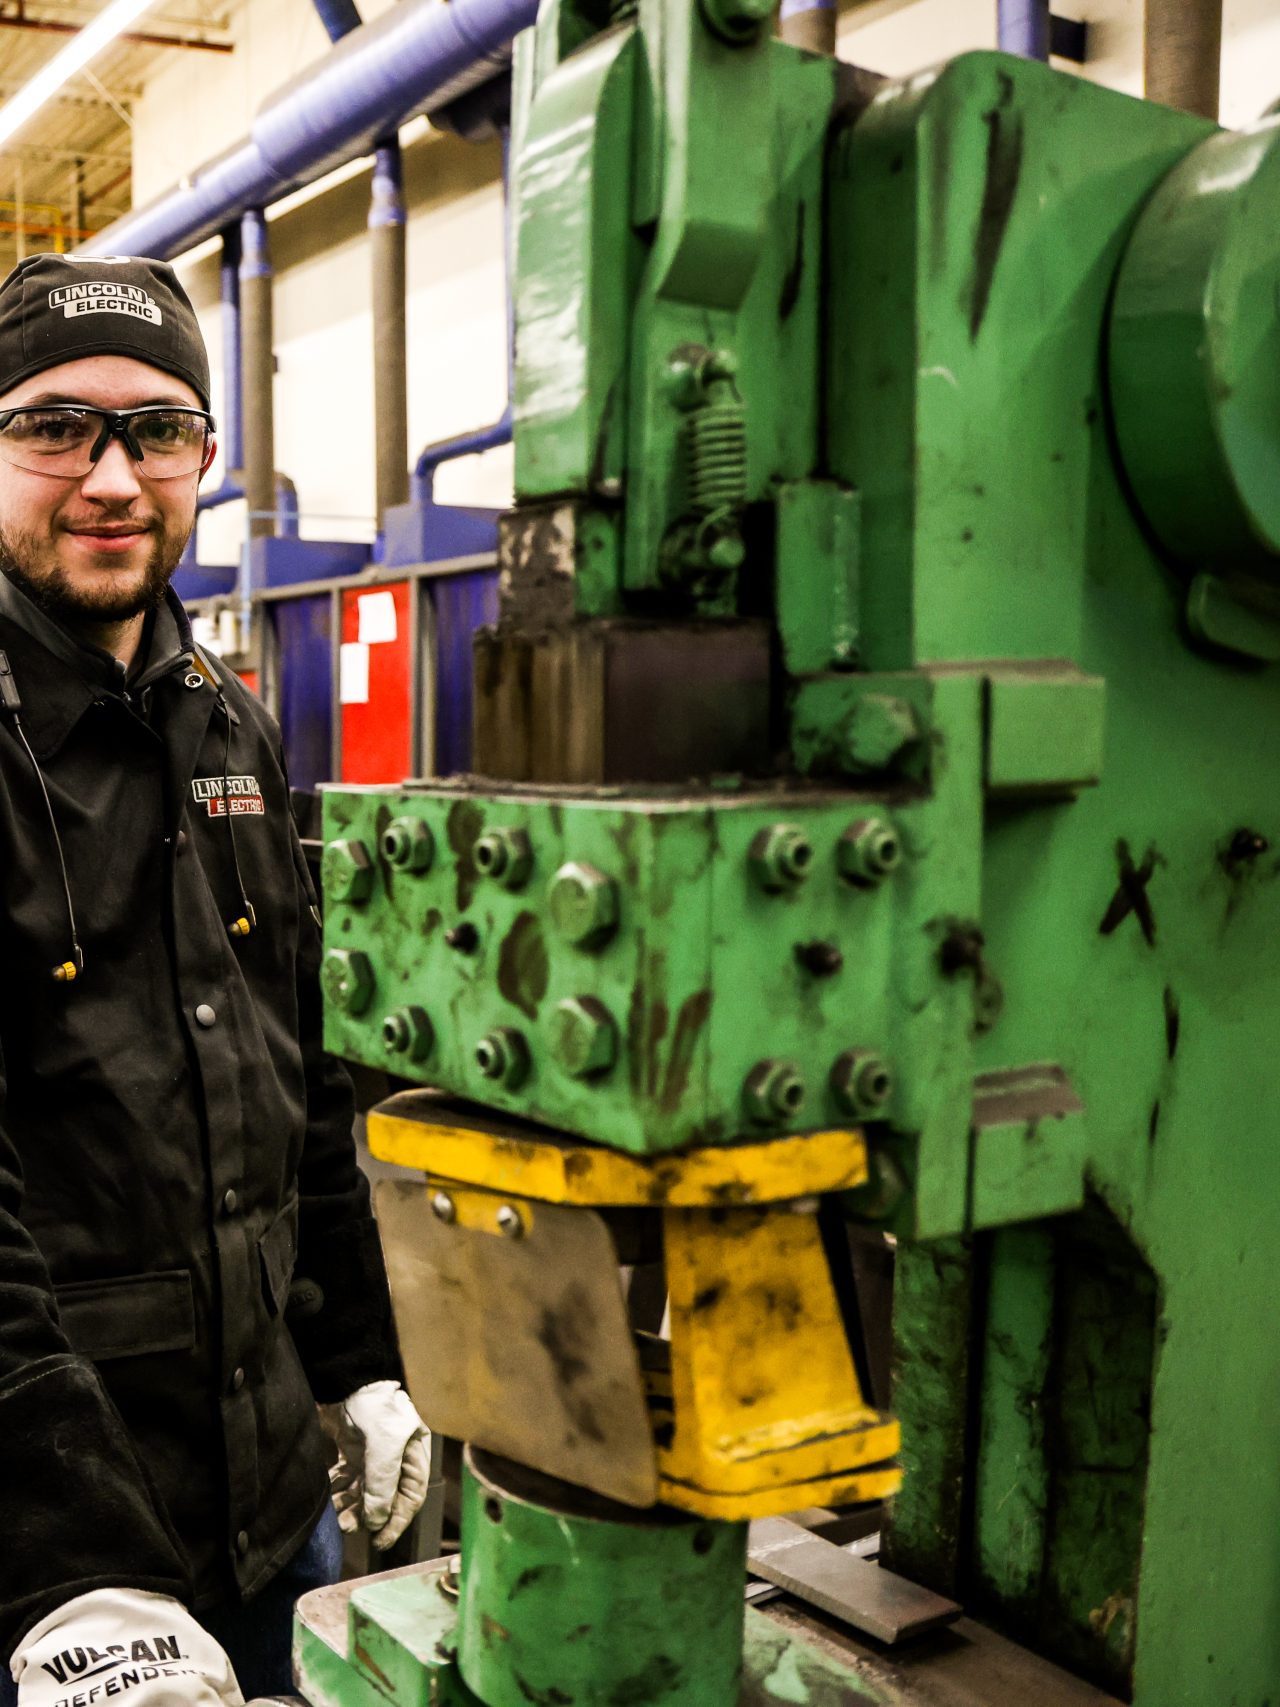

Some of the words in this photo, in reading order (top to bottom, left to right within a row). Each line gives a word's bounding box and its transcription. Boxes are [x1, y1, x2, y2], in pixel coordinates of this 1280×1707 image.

[54, 283, 143, 305] LINCOLN
[76, 299, 153, 319] ELECTRIC
[40, 1635, 181, 1684] VULCAN
